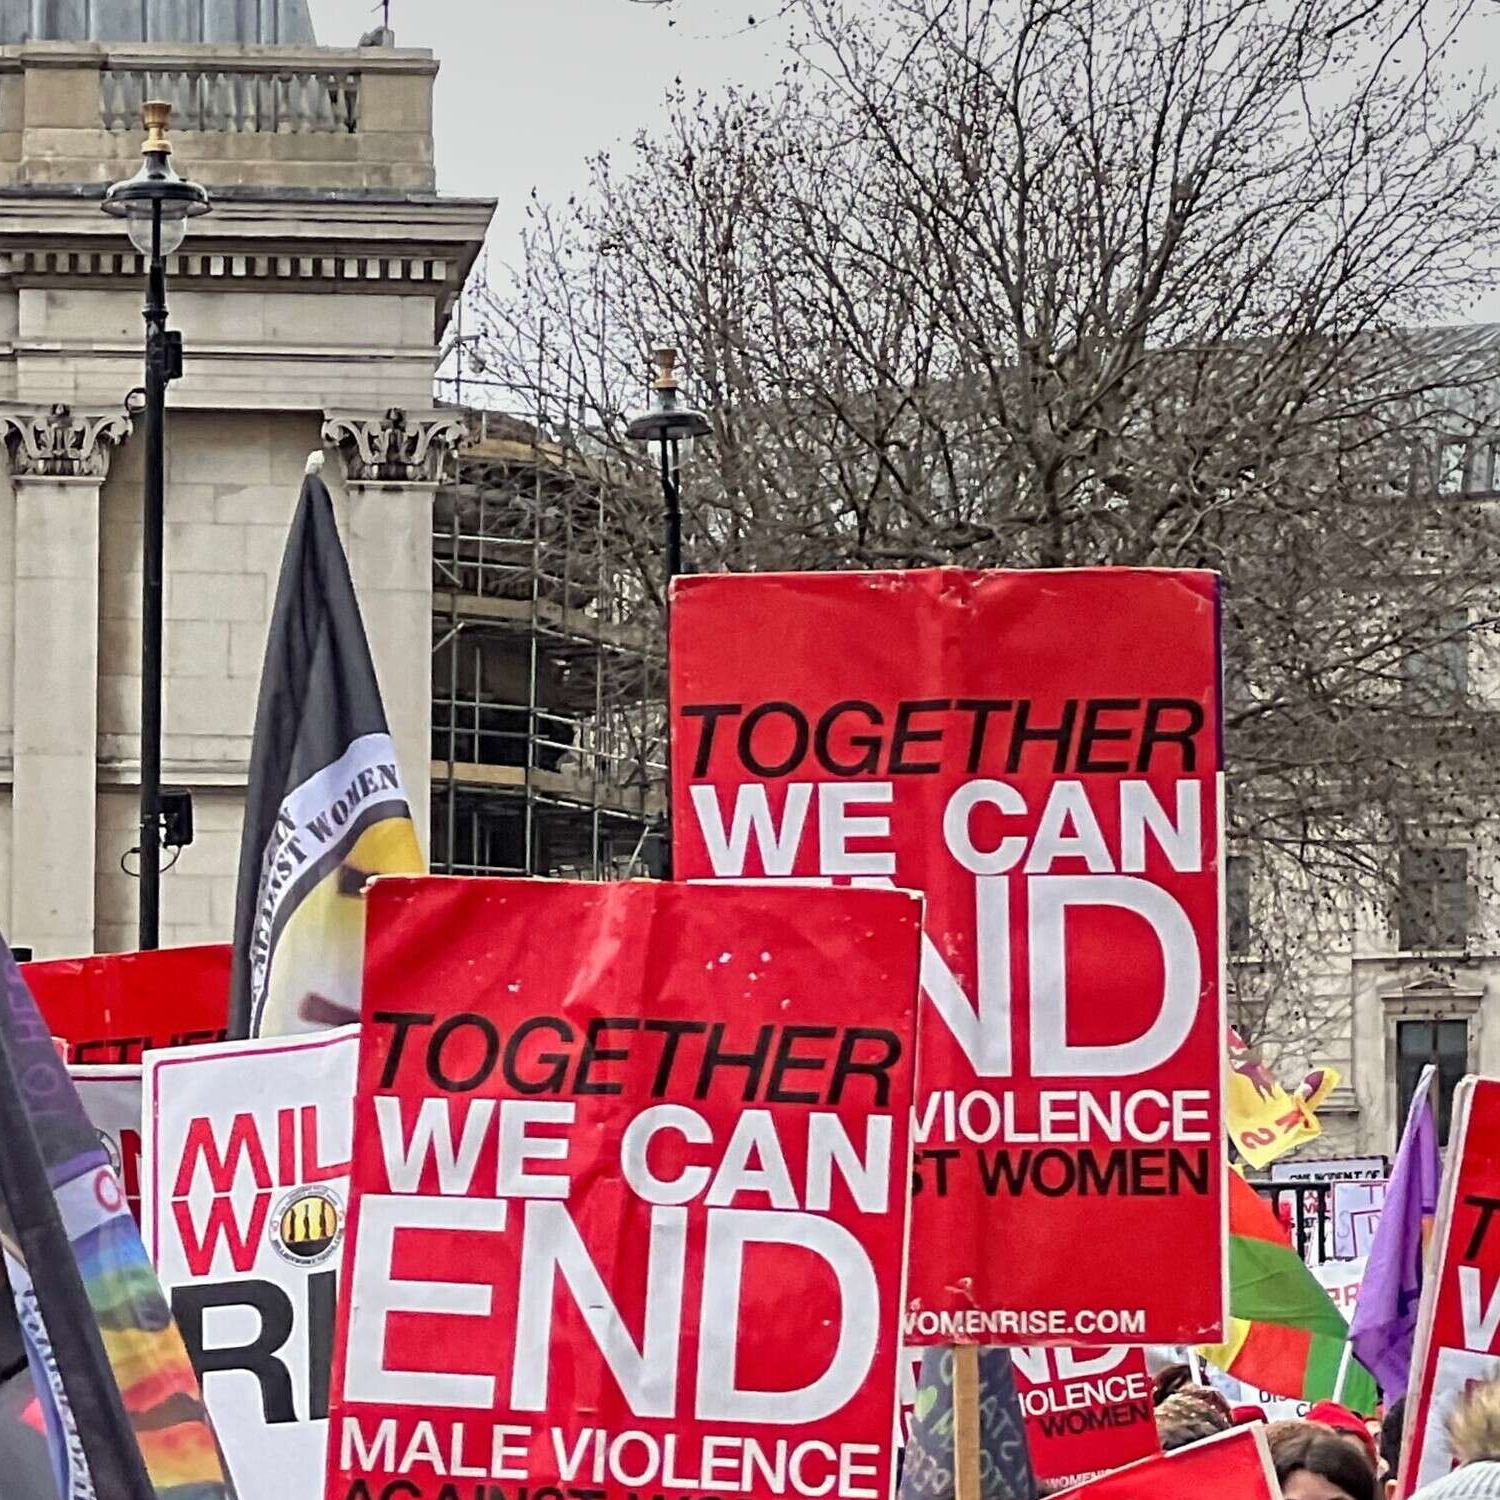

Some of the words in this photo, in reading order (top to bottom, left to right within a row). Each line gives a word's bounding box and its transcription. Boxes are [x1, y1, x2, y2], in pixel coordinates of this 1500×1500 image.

[680, 698, 1205, 779] TOGETHER
[306, 764, 399, 843] WOMEN
[690, 781, 897, 878] WE
[942, 778, 1202, 876] CAN
[921, 873, 1202, 1078] ND
[374, 1011, 901, 1106] TOGETHER
[173, 1105, 351, 1198] MIL
[375, 1095, 577, 1199] WE
[620, 1104, 892, 1214] CAN
[979, 1147, 1209, 1197] WOMEN
[342, 1194, 881, 1426] END
[340, 1417, 530, 1479] MALE
[552, 1430, 881, 1499] VIOLENCE
[1039, 1402, 1150, 1439] WOMEN
